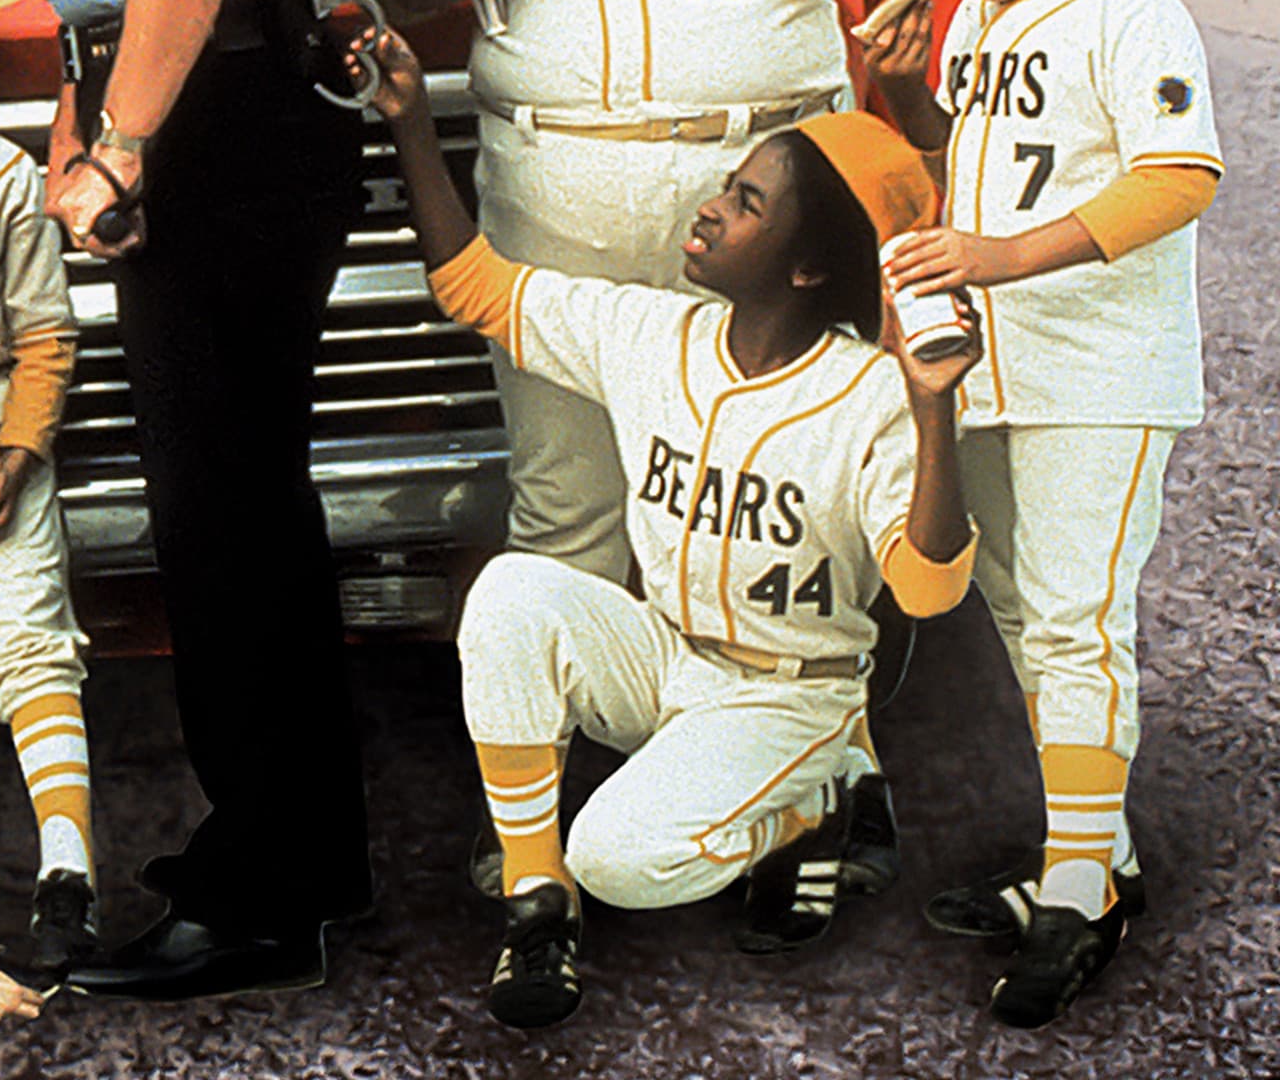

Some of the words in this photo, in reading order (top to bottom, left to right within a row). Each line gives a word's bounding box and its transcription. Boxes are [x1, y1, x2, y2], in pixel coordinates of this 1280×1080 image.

[1014, 142, 1055, 211] 7
[639, 436, 806, 548] BEARS
[747, 557, 836, 618] 44
